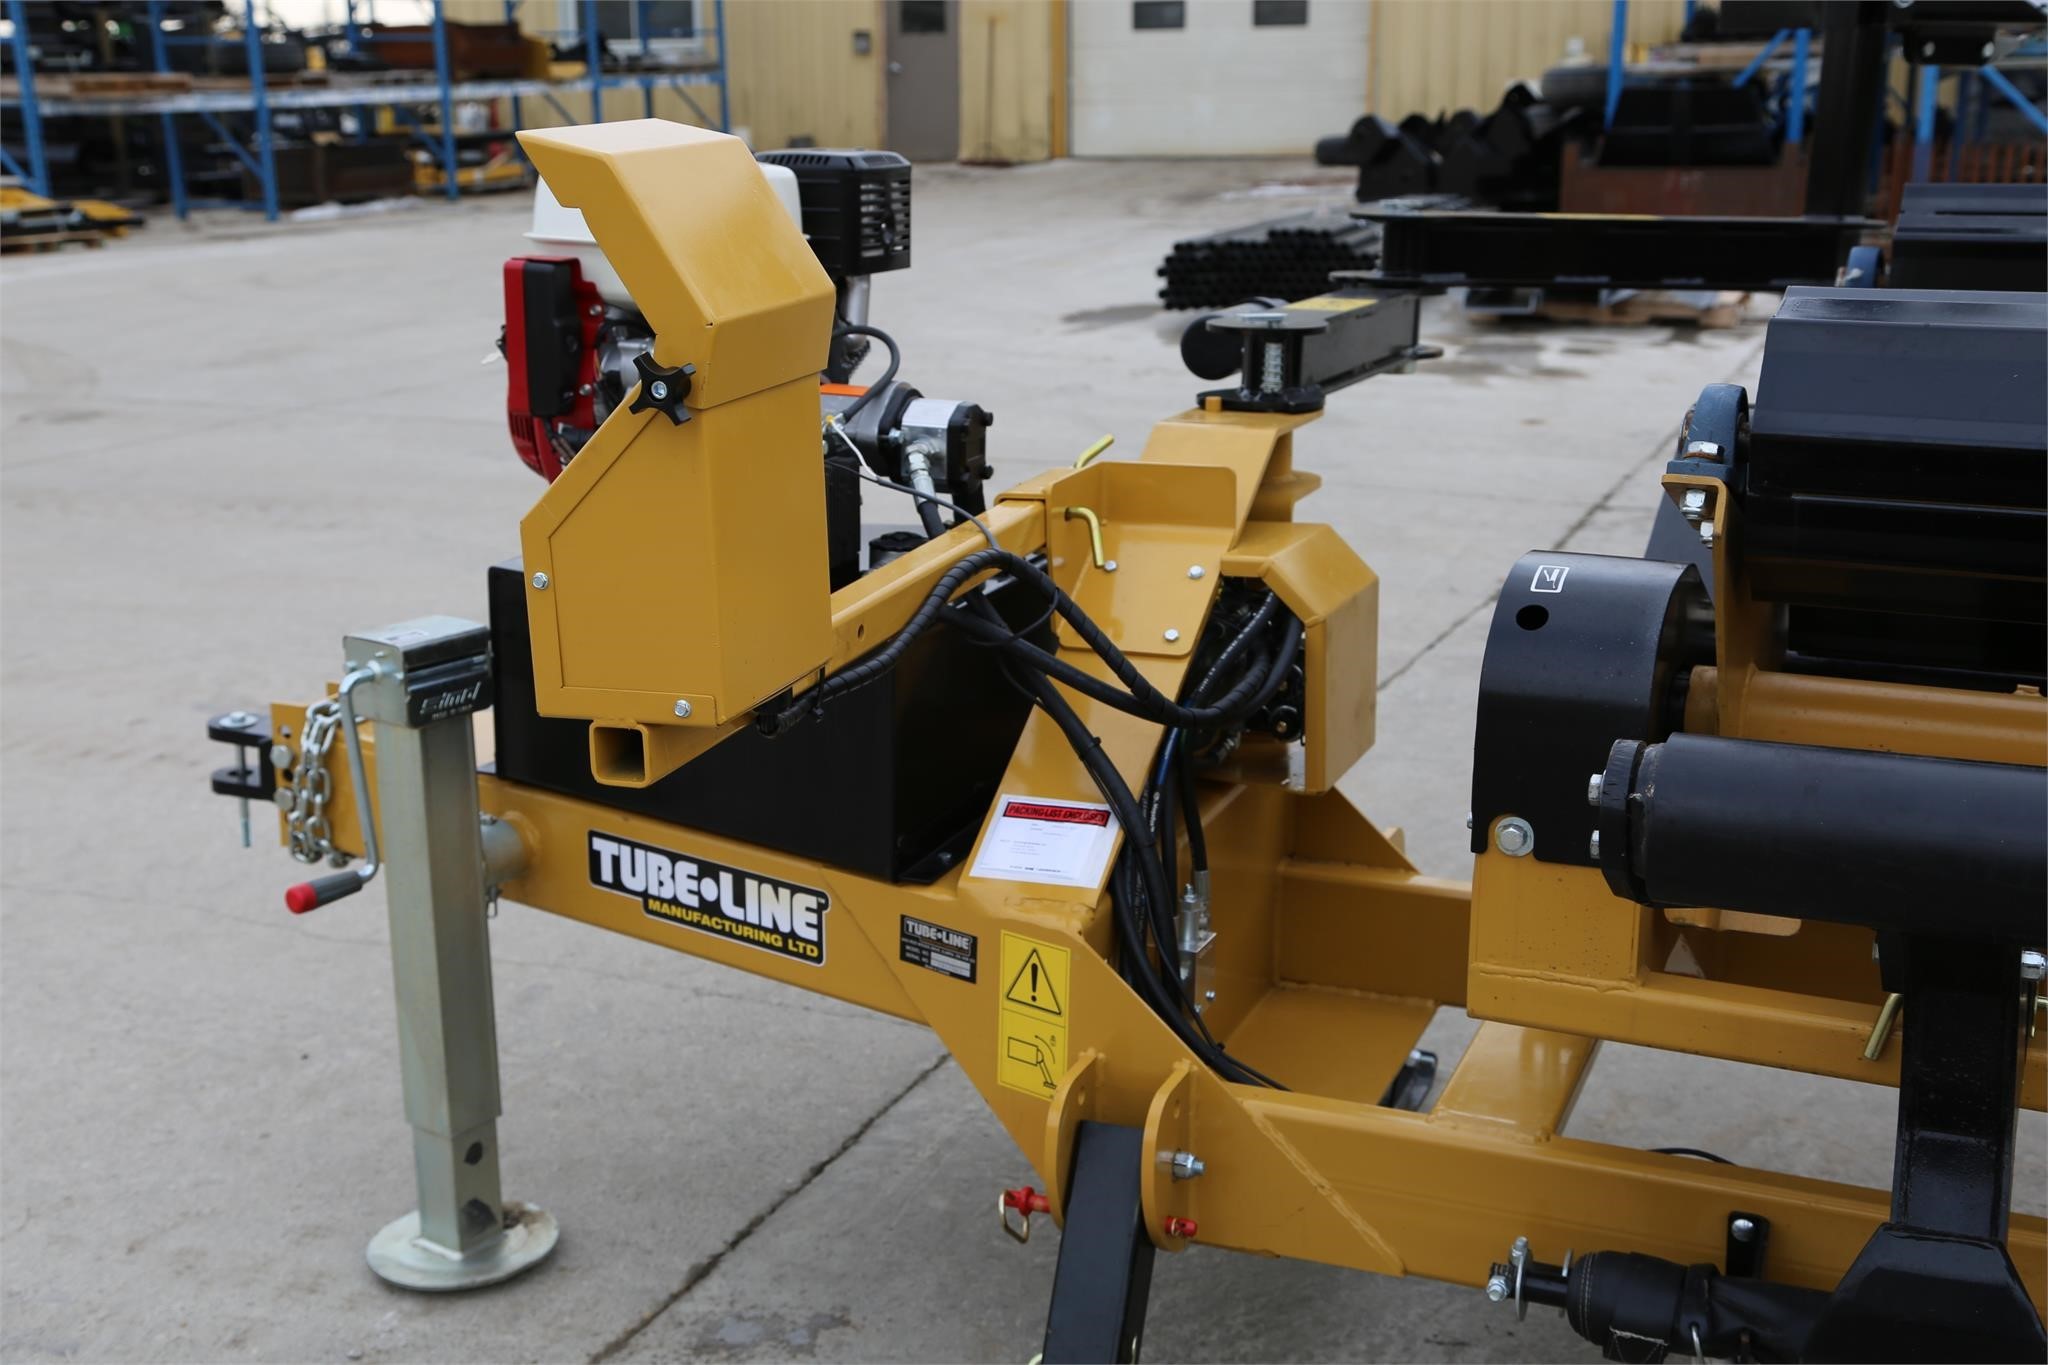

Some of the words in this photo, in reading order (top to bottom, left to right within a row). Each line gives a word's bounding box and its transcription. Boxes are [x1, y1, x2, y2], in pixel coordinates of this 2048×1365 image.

[1008, 804, 1045, 816] PACKING
[1044, 808, 1065, 819] LIST
[648, 898, 783, 947] MANUFACTURING
[788, 938, 819, 957] LTD
